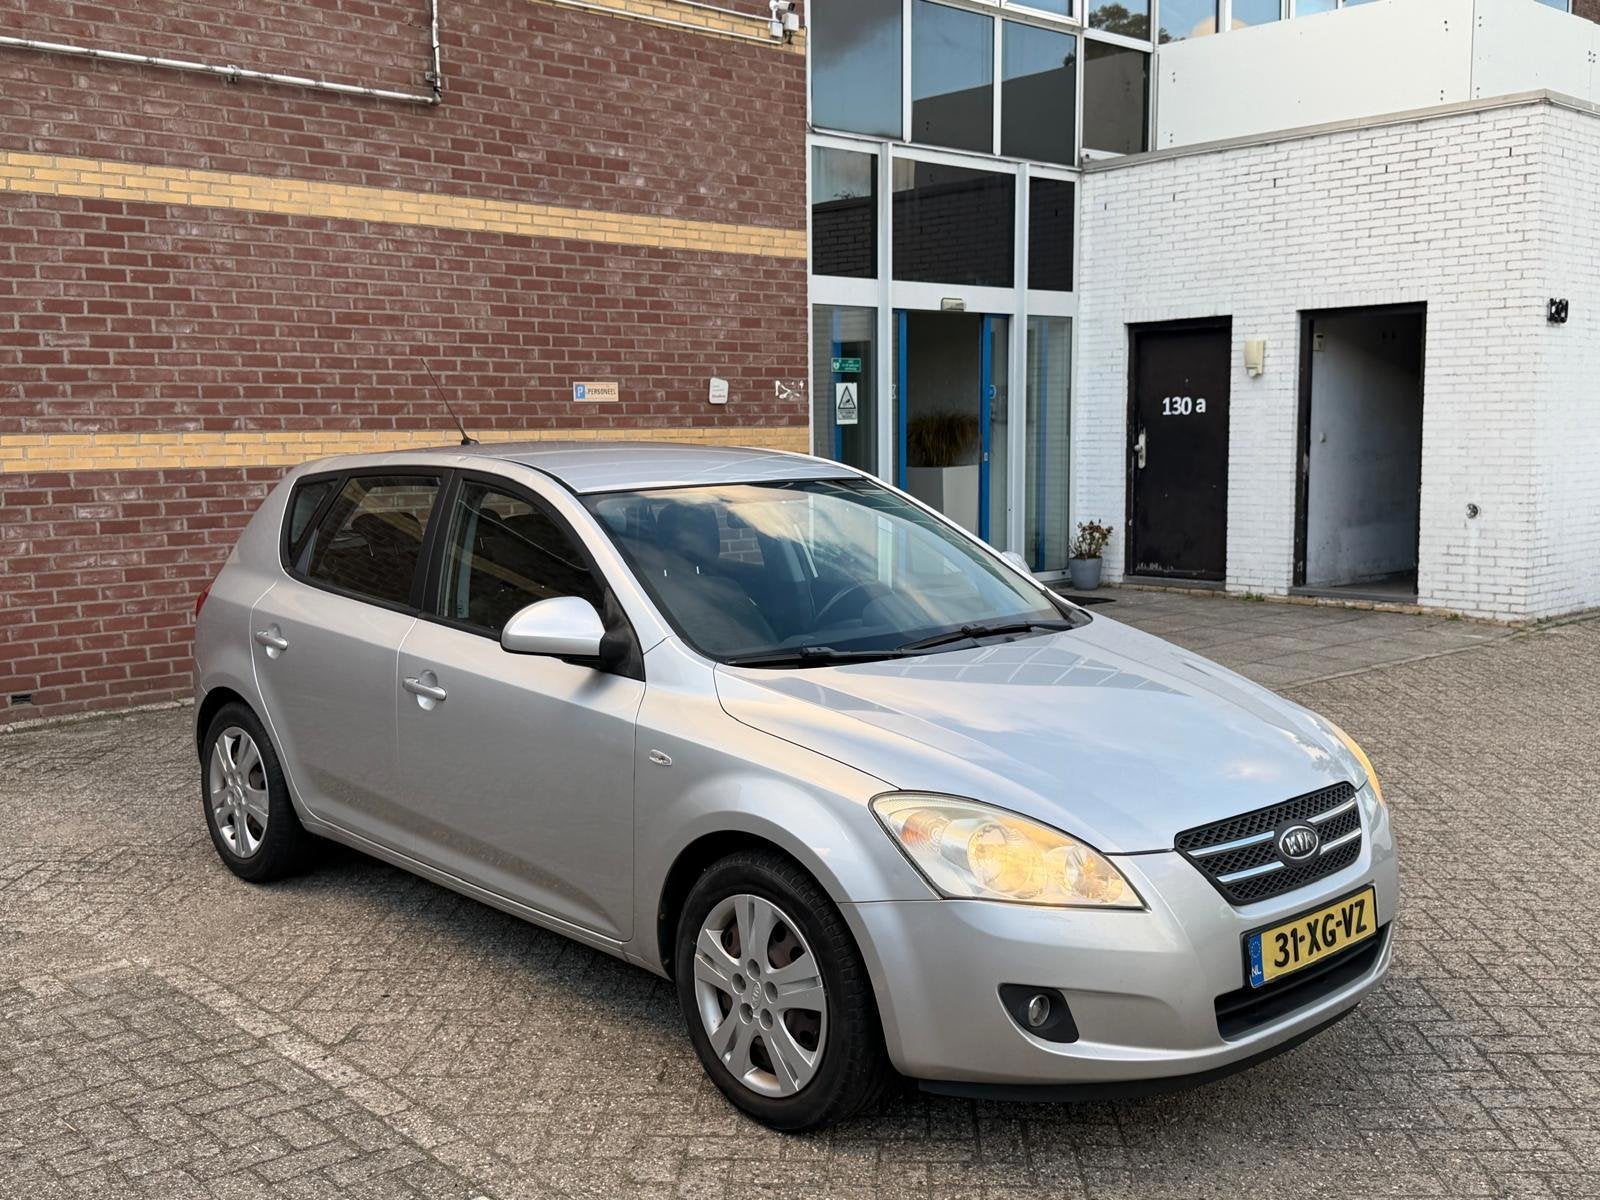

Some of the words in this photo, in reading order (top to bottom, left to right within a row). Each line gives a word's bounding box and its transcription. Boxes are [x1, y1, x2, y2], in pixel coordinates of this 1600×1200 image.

[577, 386, 584, 397] P
[1162, 396, 1193, 416] 130
[1195, 398, 1206, 414] a
[1284, 831, 1315, 855] KIA
[1274, 898, 1367, 968] 31-XG-VZ
[1251, 964, 1262, 977] NL
